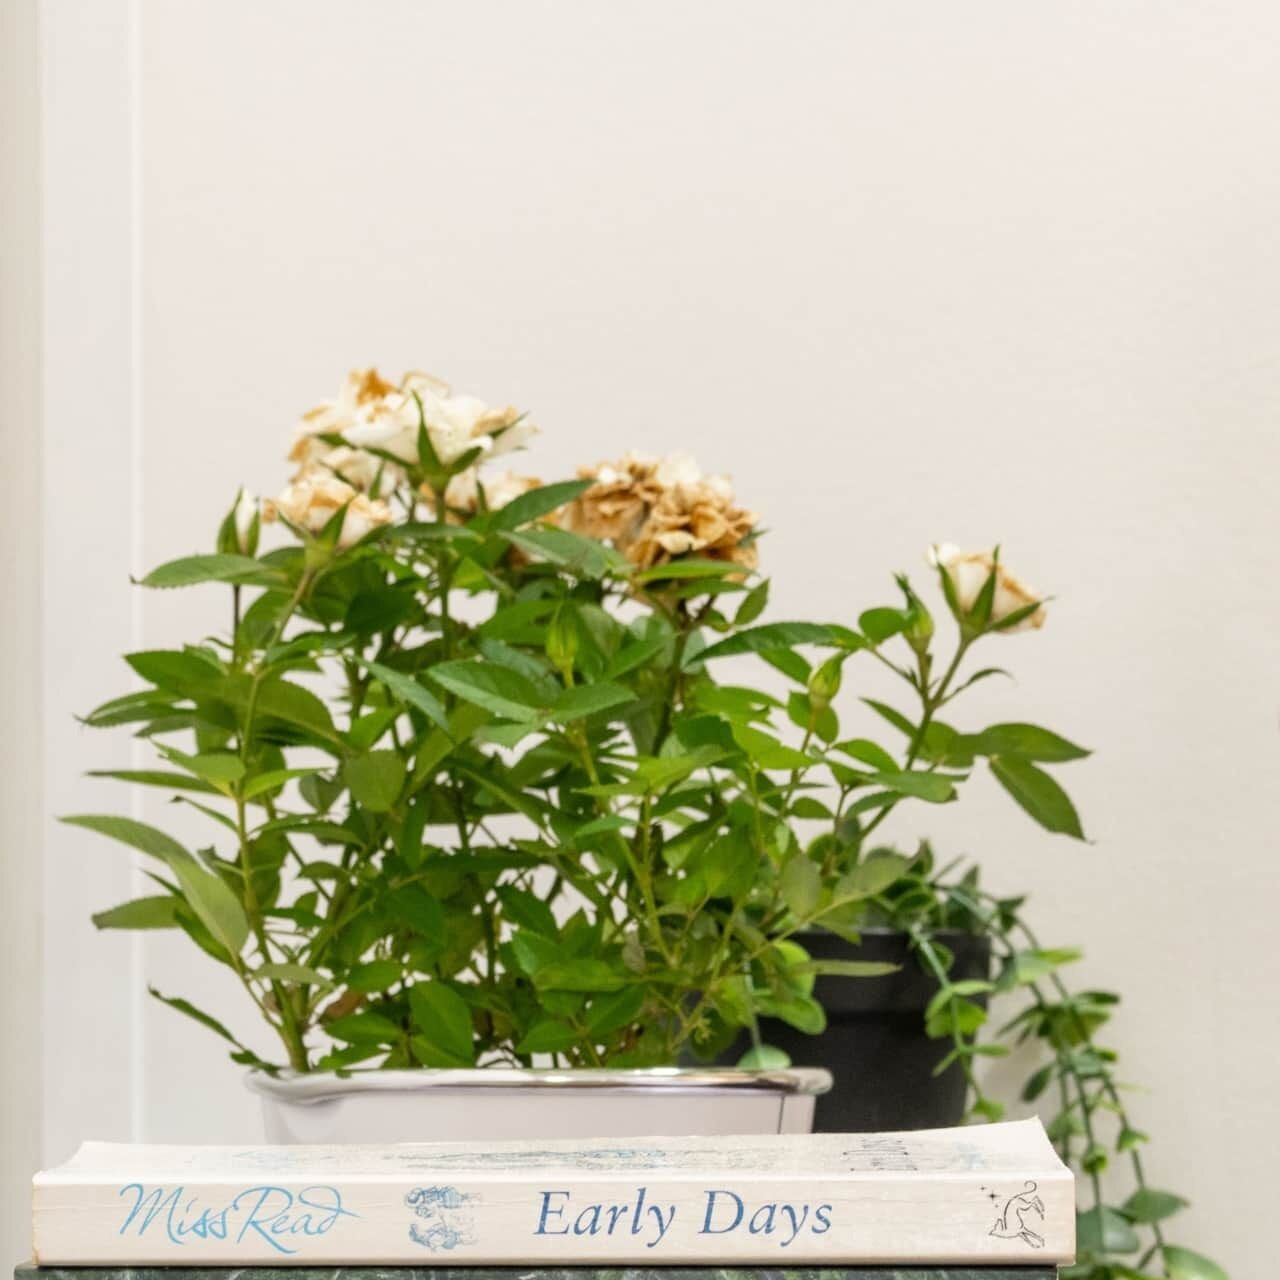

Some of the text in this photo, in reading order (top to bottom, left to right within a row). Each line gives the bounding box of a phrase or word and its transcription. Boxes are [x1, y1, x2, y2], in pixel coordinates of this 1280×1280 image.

[119, 1183, 360, 1254] Miss Read
[534, 1187, 834, 1248] Early Days
